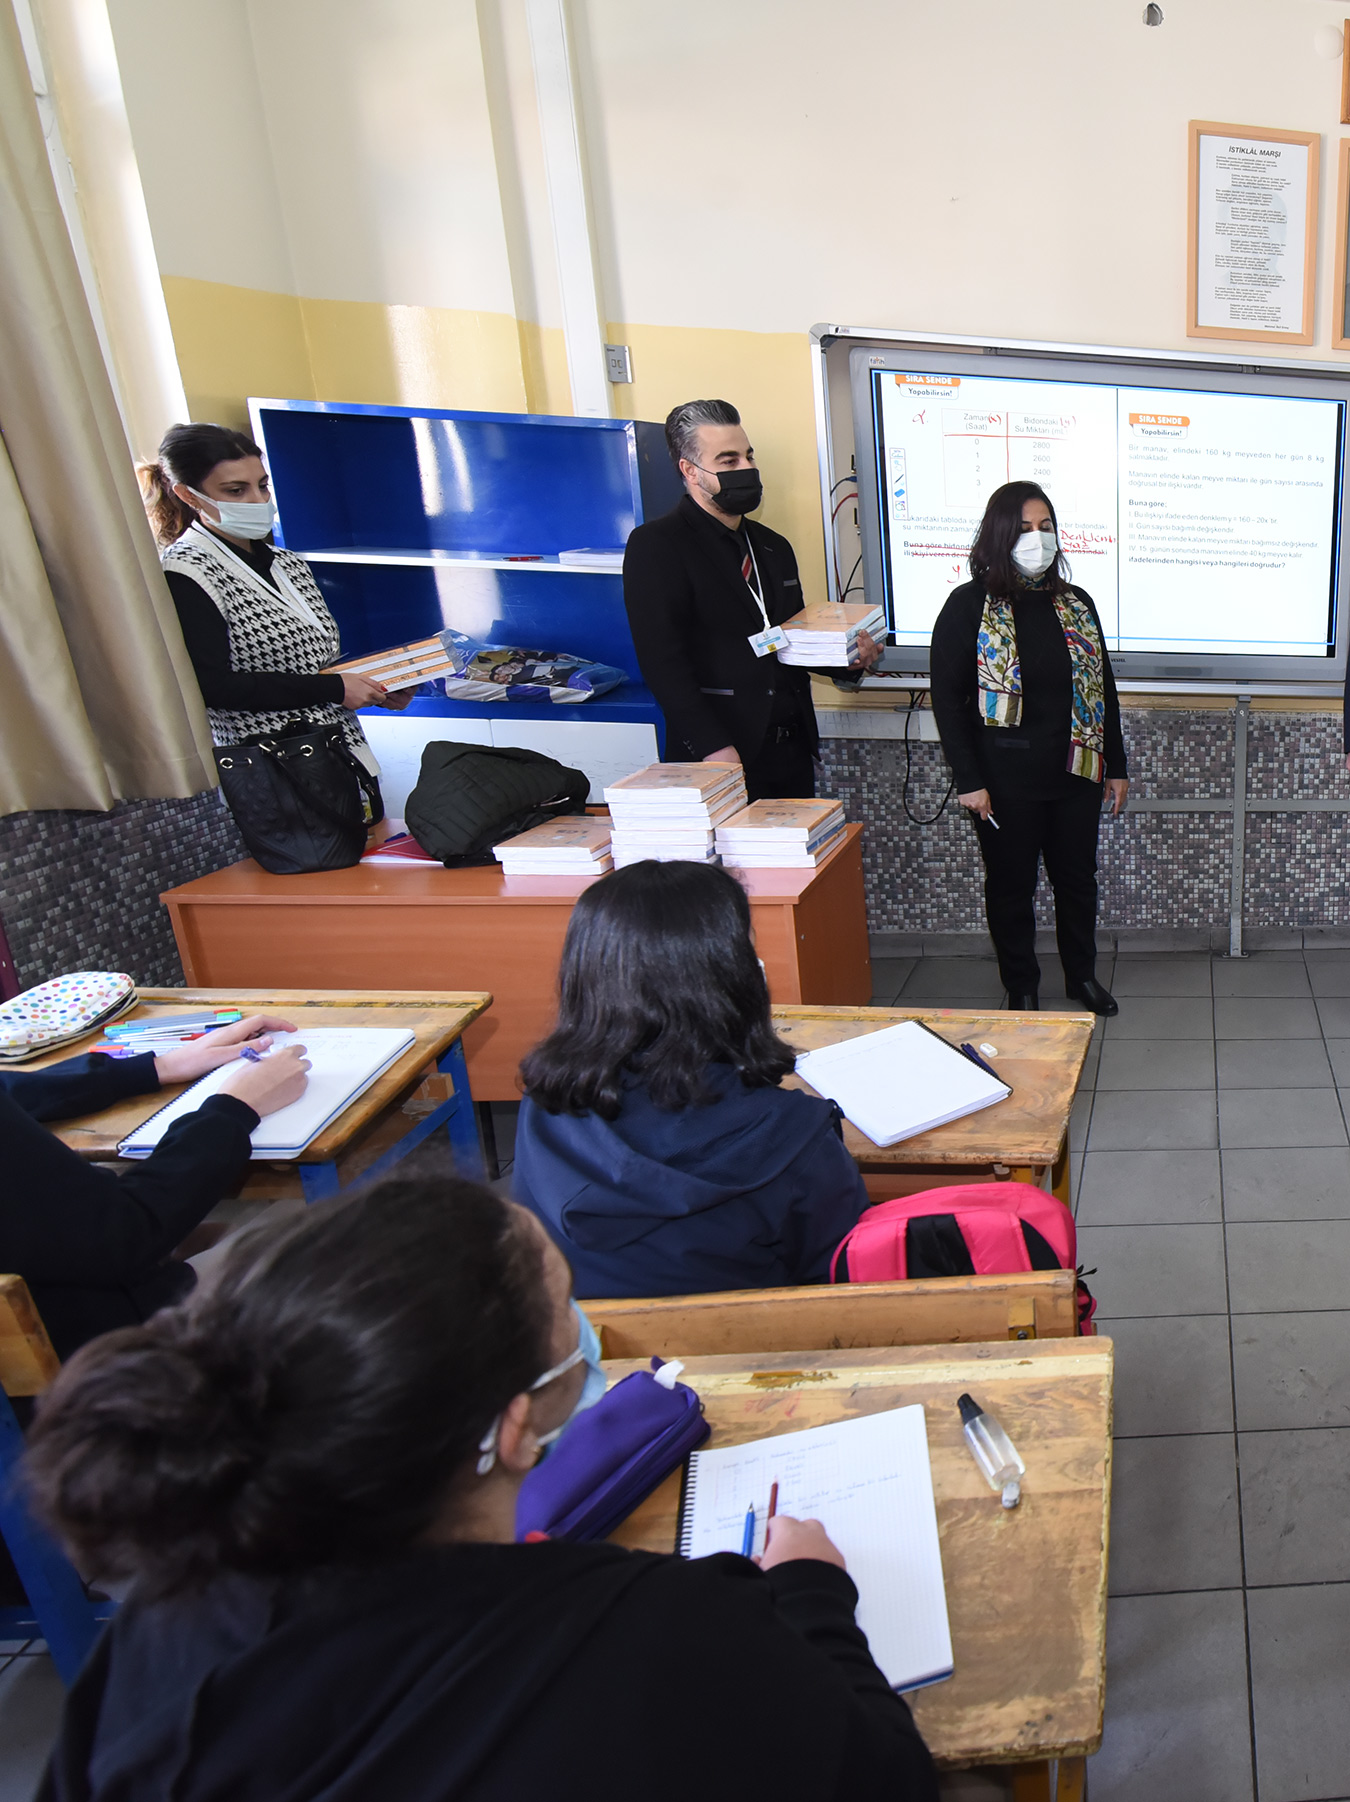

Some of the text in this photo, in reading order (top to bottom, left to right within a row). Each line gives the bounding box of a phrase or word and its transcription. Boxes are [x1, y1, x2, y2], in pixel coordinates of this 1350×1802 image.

[1228, 145, 1282, 158] İSTİKLÂL MARŞI
[906, 375, 952, 385] SIRA SENDE
[1138, 414, 1182, 425] SIRA SENDE
[966, 423, 988, 432] (Saat)
[1222, 450, 1231, 458] kg
[1316, 455, 1324, 464] kg
